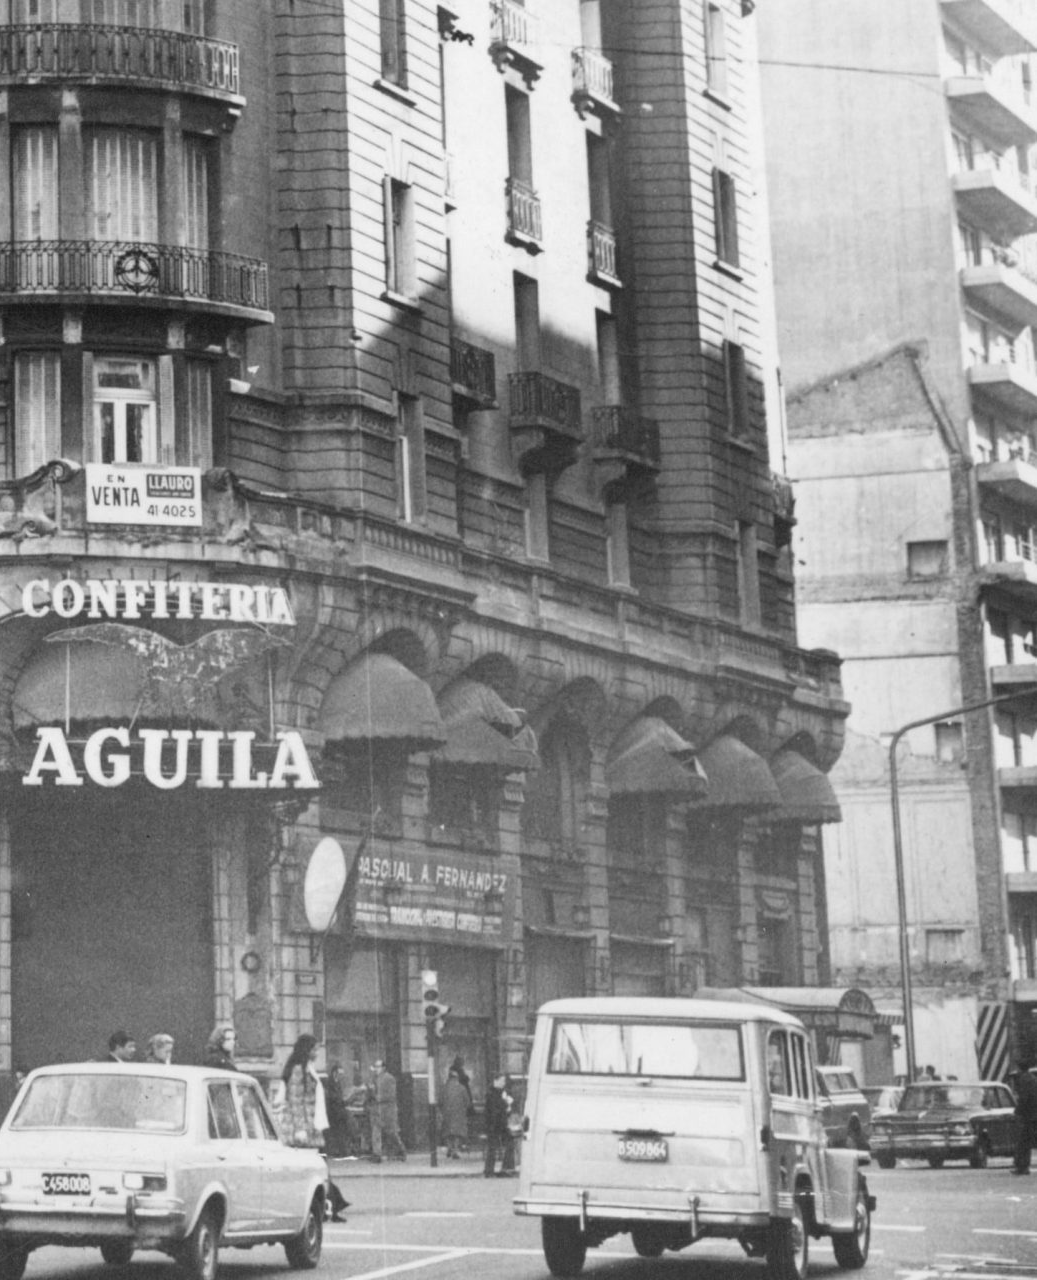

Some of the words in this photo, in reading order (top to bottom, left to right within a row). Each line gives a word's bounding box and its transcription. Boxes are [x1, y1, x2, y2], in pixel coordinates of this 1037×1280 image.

[107, 475, 125, 483] EN
[148, 475, 192, 491] LLAURO
[92, 486, 140, 507] VENTA
[162, 505, 196, 518] 4025
[22, 578, 297, 625] CONFITERIA
[22, 726, 323, 789] AGUILA
